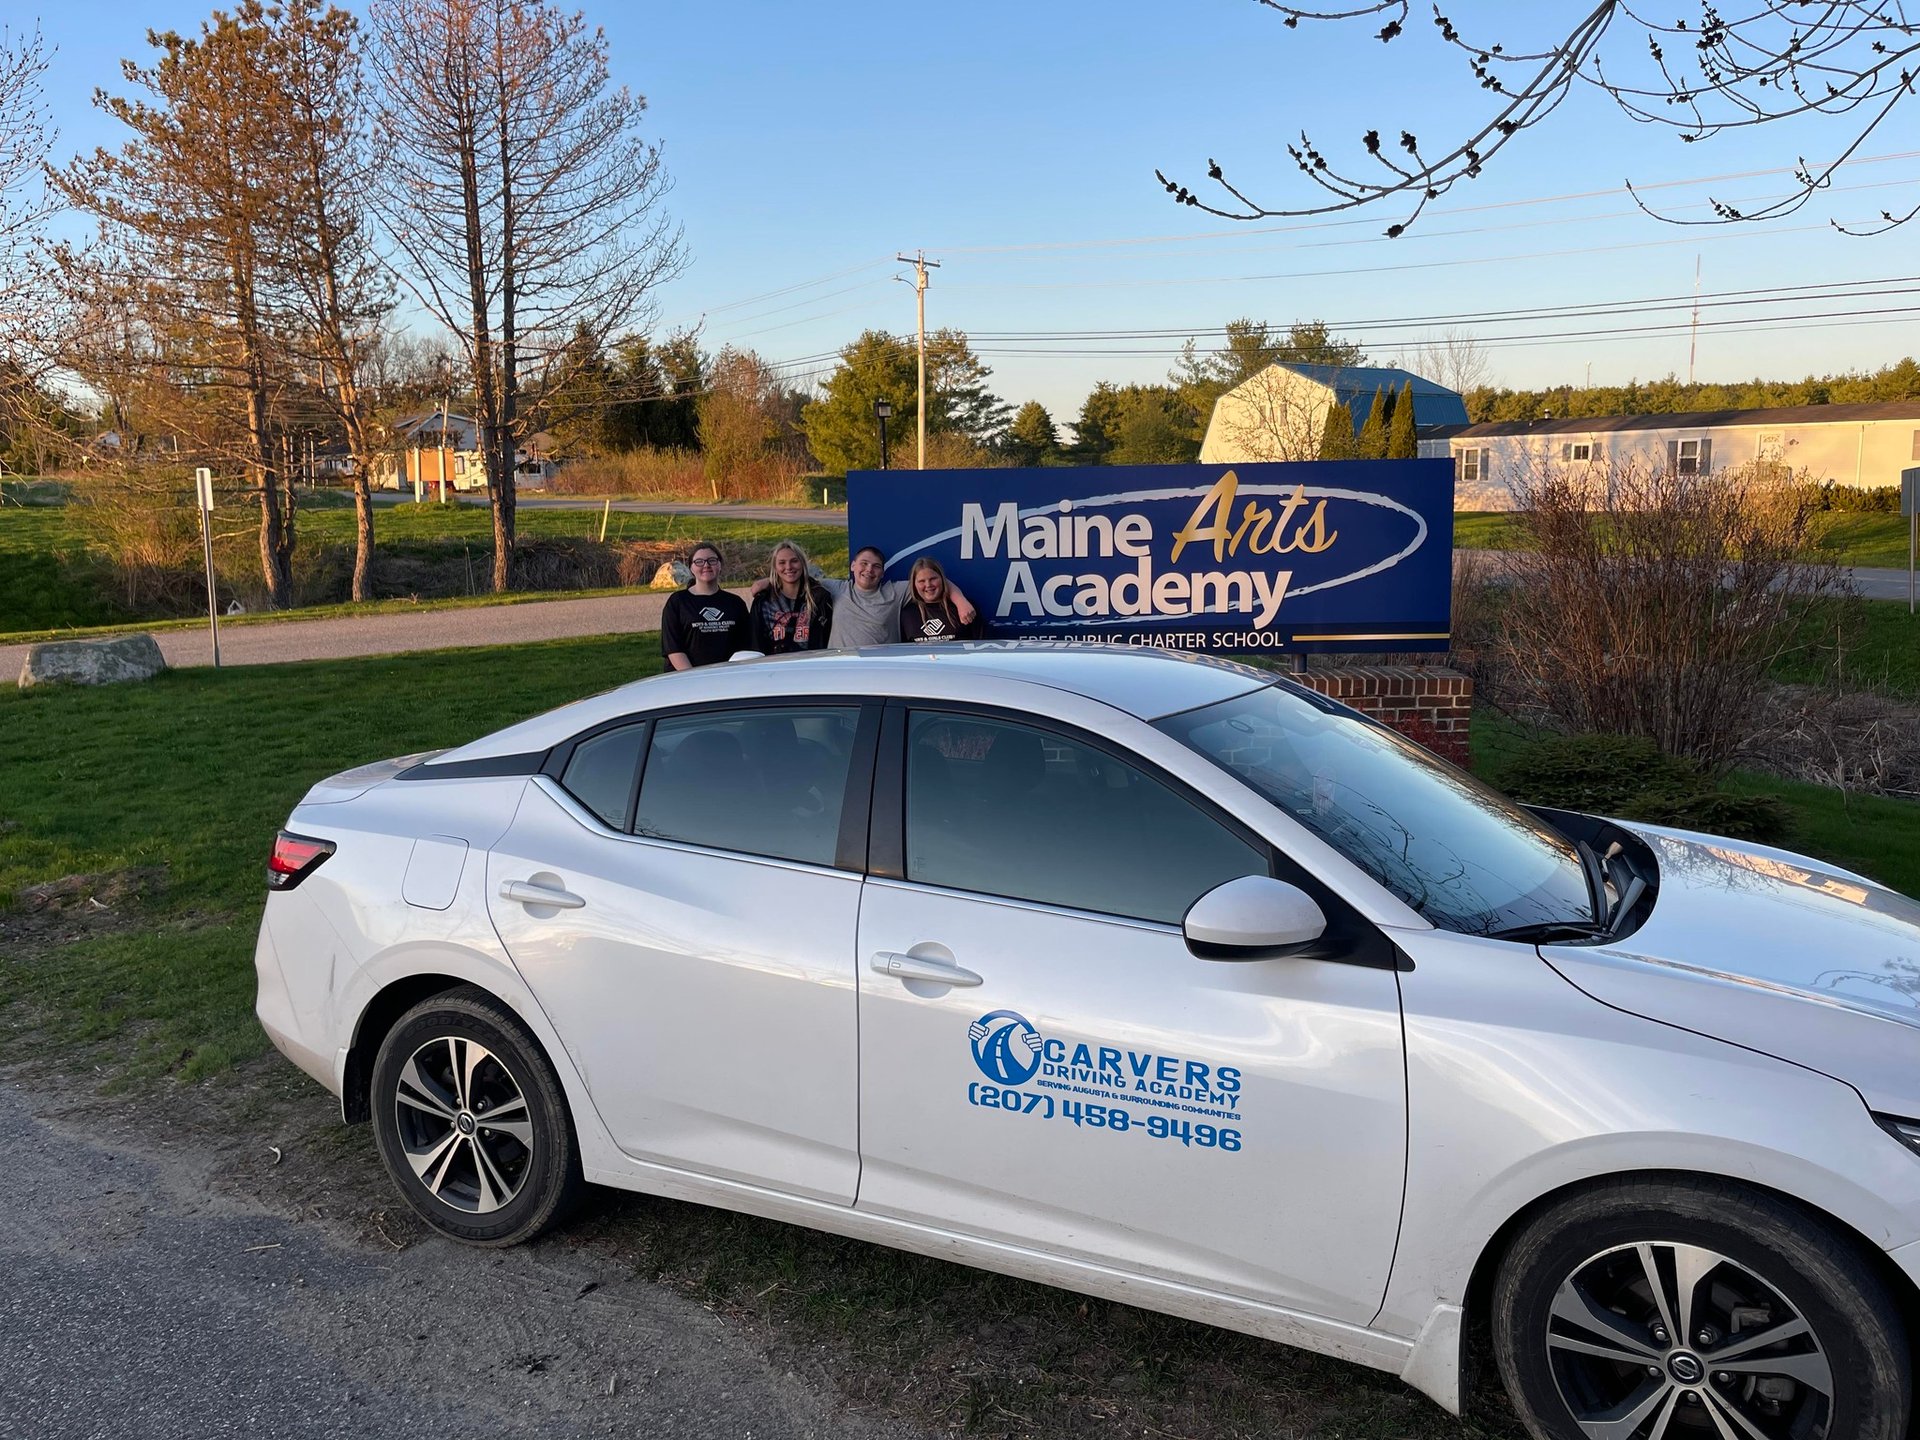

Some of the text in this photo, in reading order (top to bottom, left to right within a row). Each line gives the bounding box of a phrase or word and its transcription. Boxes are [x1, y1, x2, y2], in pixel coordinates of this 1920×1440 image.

[960, 470, 1338, 564] Maine Arts
[995, 555, 1293, 629] Academy
[1129, 633, 1207, 649] CHARTER
[1212, 631, 1284, 648] SCHOOL
[1043, 1039, 1242, 1092] CARVERS
[1043, 1063, 1241, 1110] DRIVING ACADEMY
[968, 1082, 1242, 1152] (207) 458-9496
[1037, 1079, 1071, 1091] SERVING
[1072, 1086, 1111, 1098] AUGUSTA
[1120, 1093, 1181, 1111] SURROUNDING
[1181, 1104, 1242, 1121] COMMUNITIES
